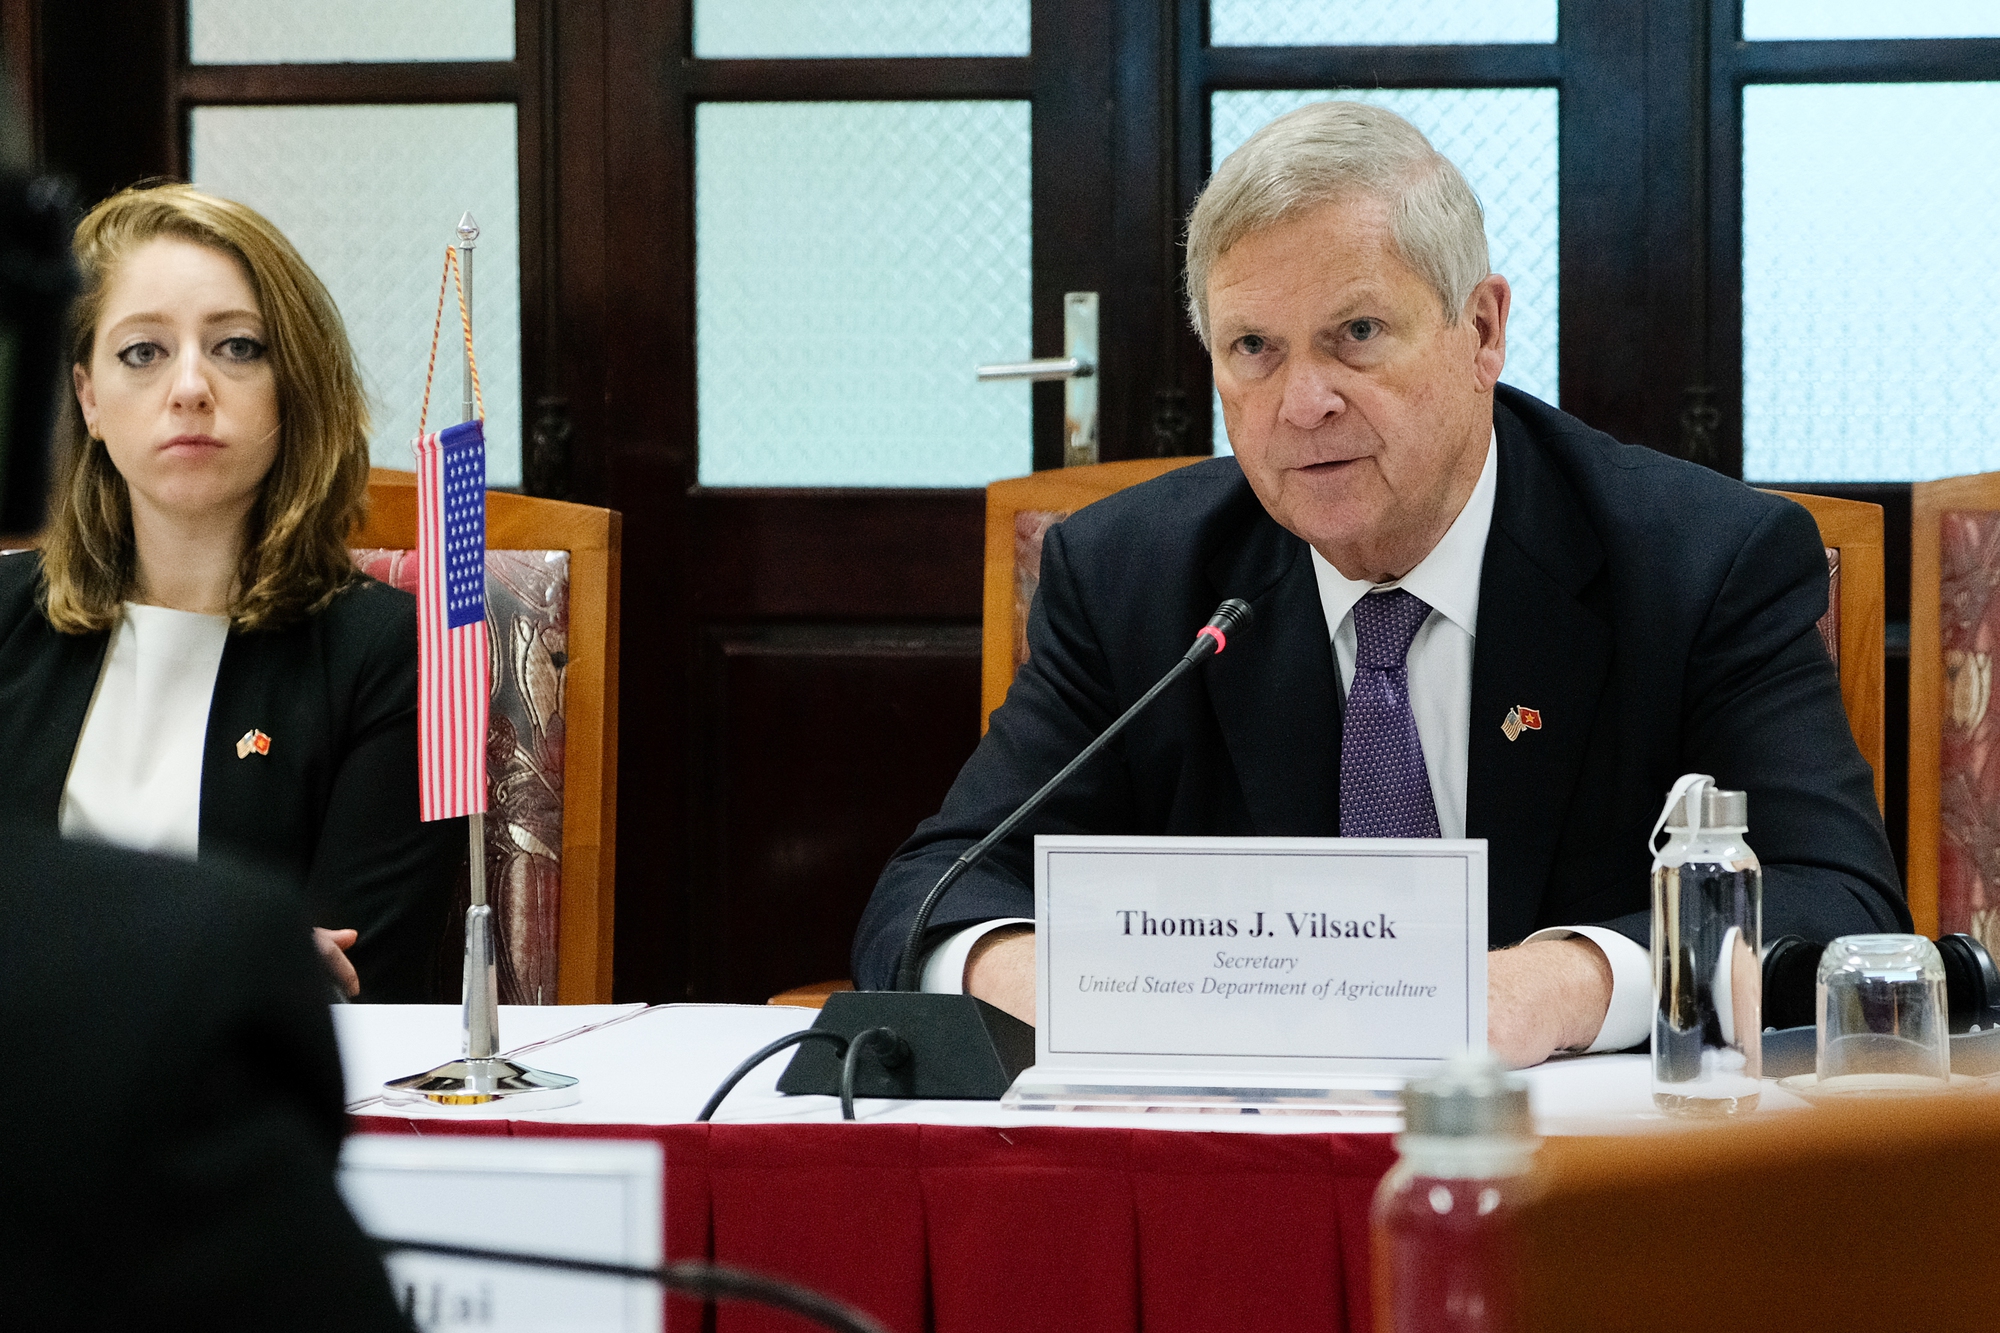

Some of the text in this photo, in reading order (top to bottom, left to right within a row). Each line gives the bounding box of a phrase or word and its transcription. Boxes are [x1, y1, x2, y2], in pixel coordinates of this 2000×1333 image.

[1116, 910, 1398, 940] Thomas J. Vilsack
[1213, 951, 1299, 973] Secretary
[1078, 975, 1438, 1001] United States Department of Agriculture
